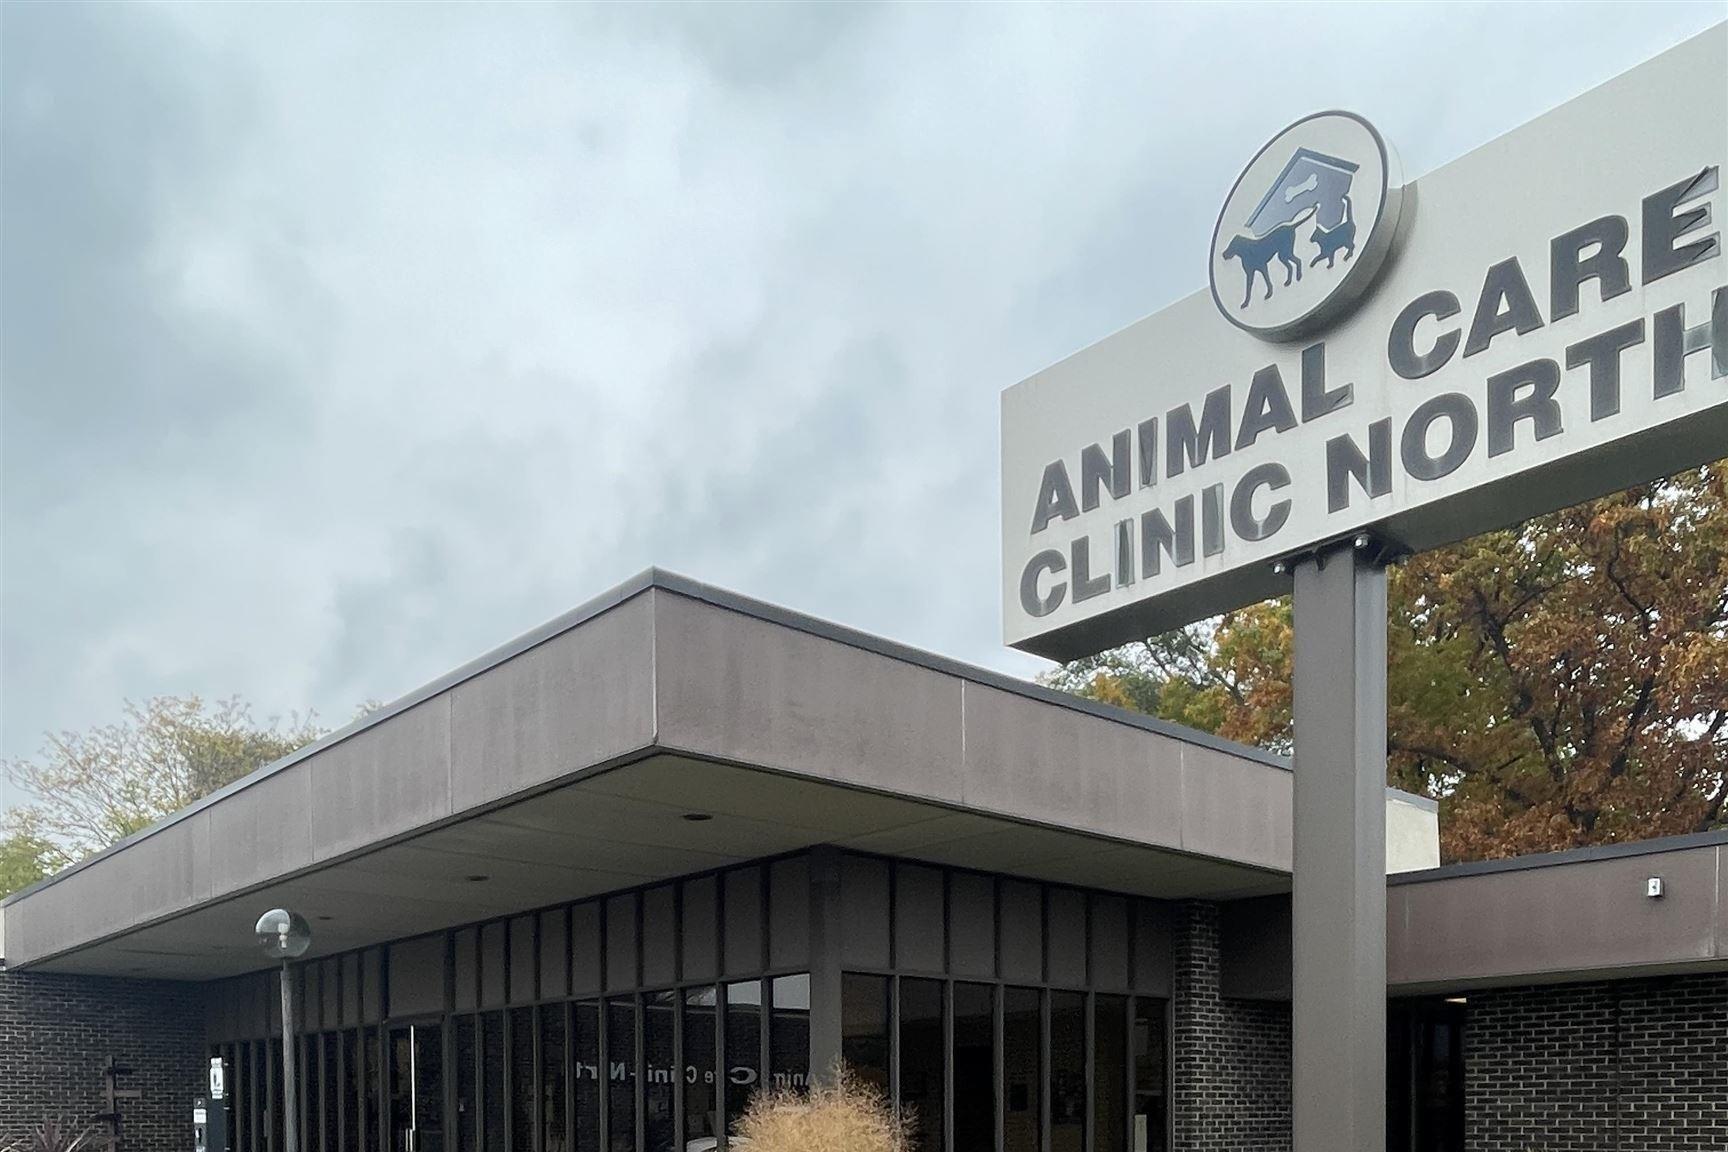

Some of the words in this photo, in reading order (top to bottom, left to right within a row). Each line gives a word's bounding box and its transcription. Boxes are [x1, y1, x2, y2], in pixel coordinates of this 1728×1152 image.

[1020, 463, 1292, 618] CLINIC
[1325, 285, 1728, 514] NORTH
[1031, 342, 1353, 534] ANIMAL
[1388, 166, 1720, 379] CARE
